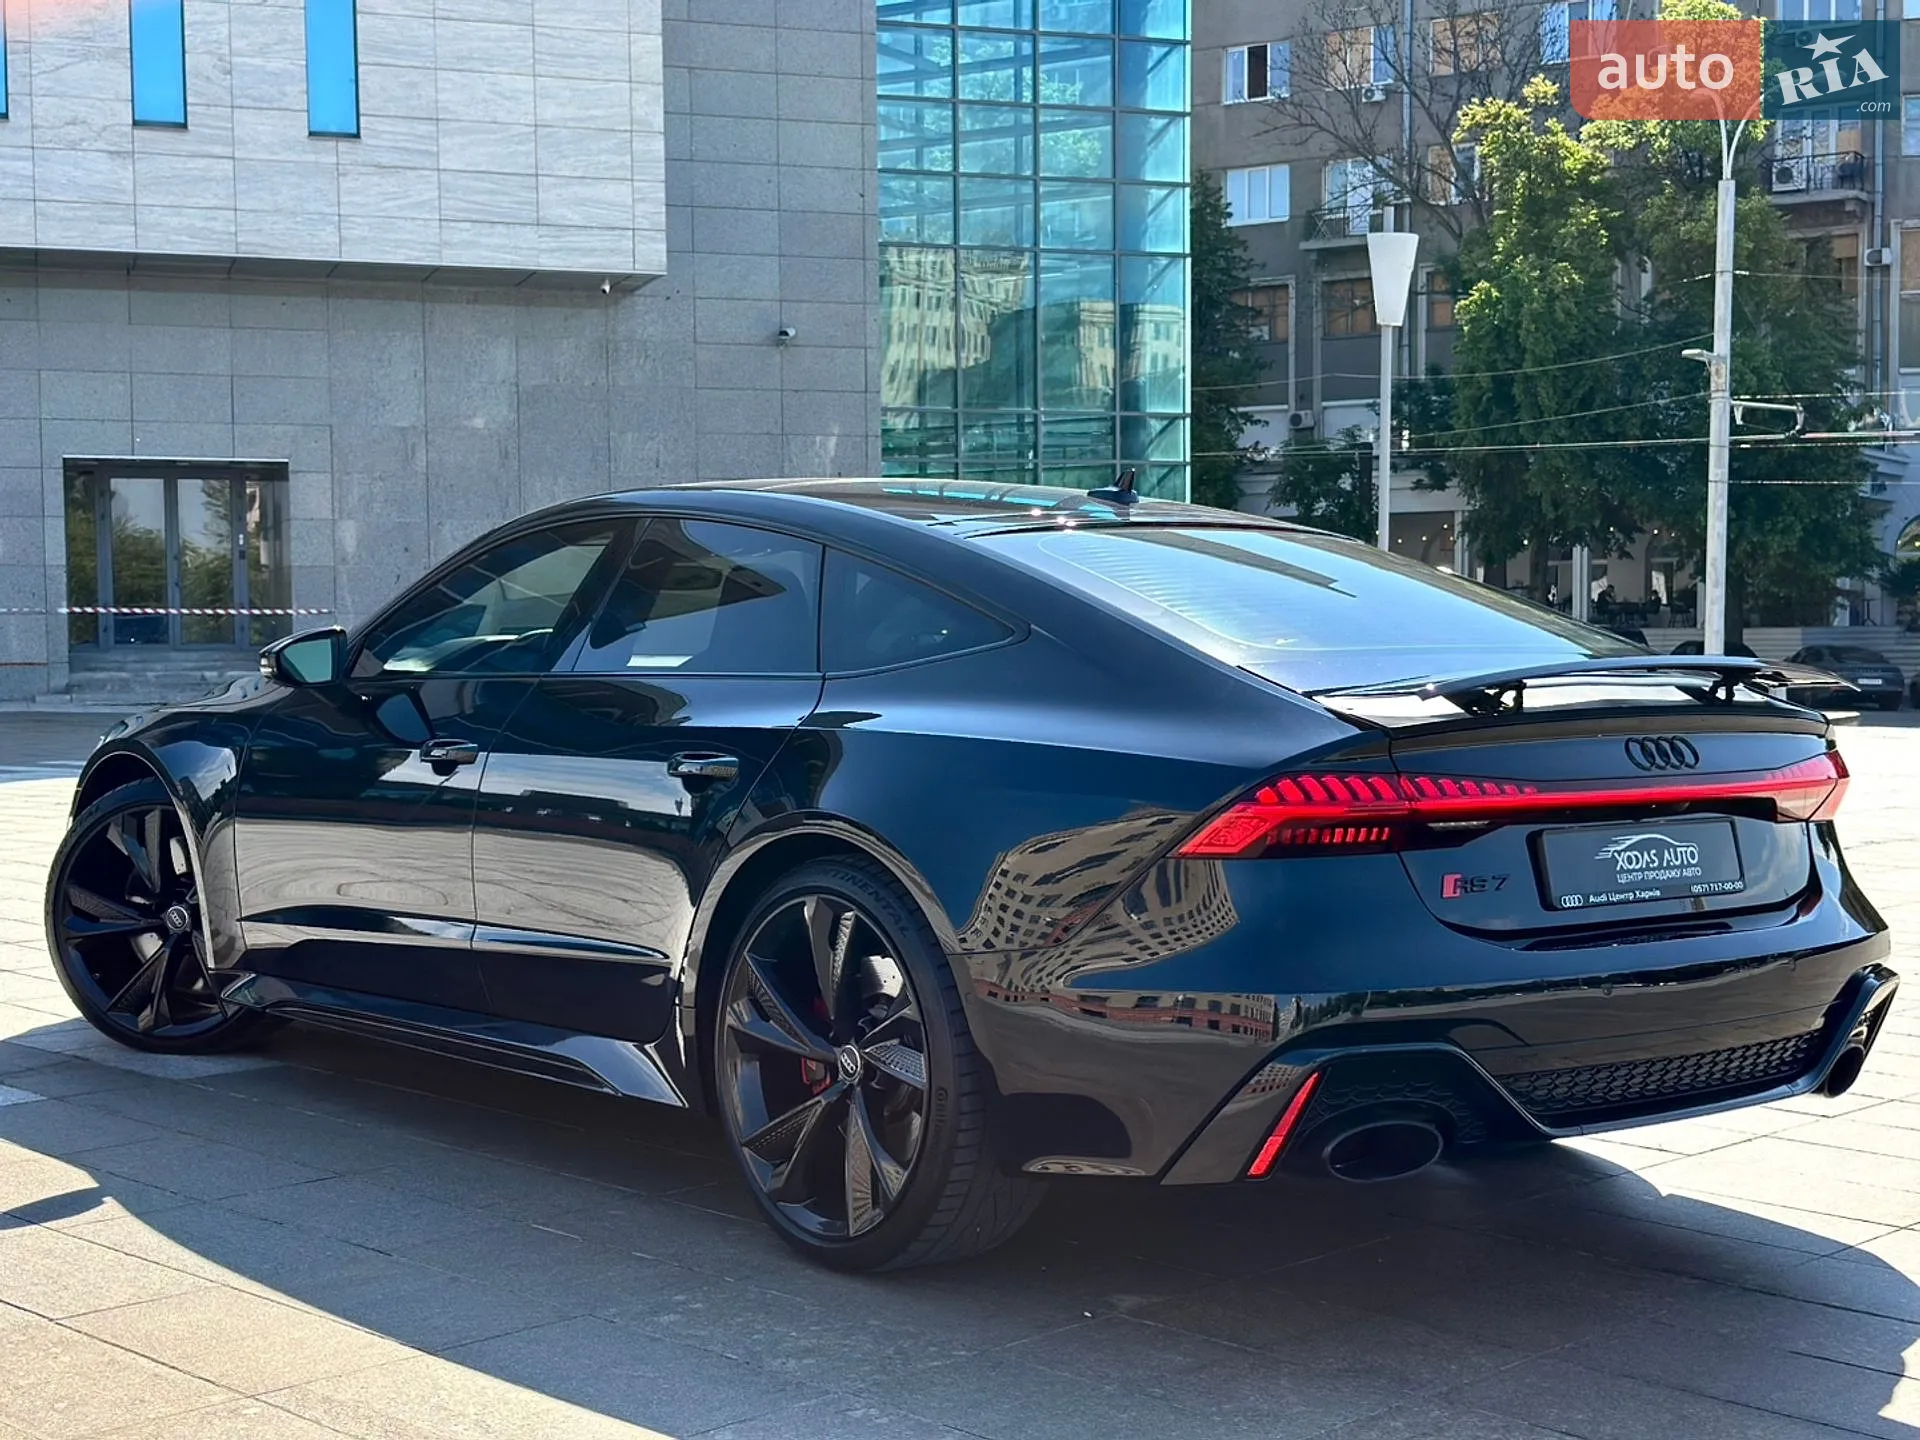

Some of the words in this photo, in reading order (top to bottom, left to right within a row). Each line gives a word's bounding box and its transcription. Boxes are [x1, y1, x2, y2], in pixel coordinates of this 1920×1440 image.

[1614, 849, 1659, 871] XODAS
[1663, 846, 1699, 867] AUTO
[1616, 871, 1644, 884] ЦЕНТР
[1644, 868, 1681, 881] ПРОДАЖУ
[1682, 867, 1702, 878] АВТО
[1589, 893, 1608, 903] Audi
[1608, 891, 1634, 903] Центр
